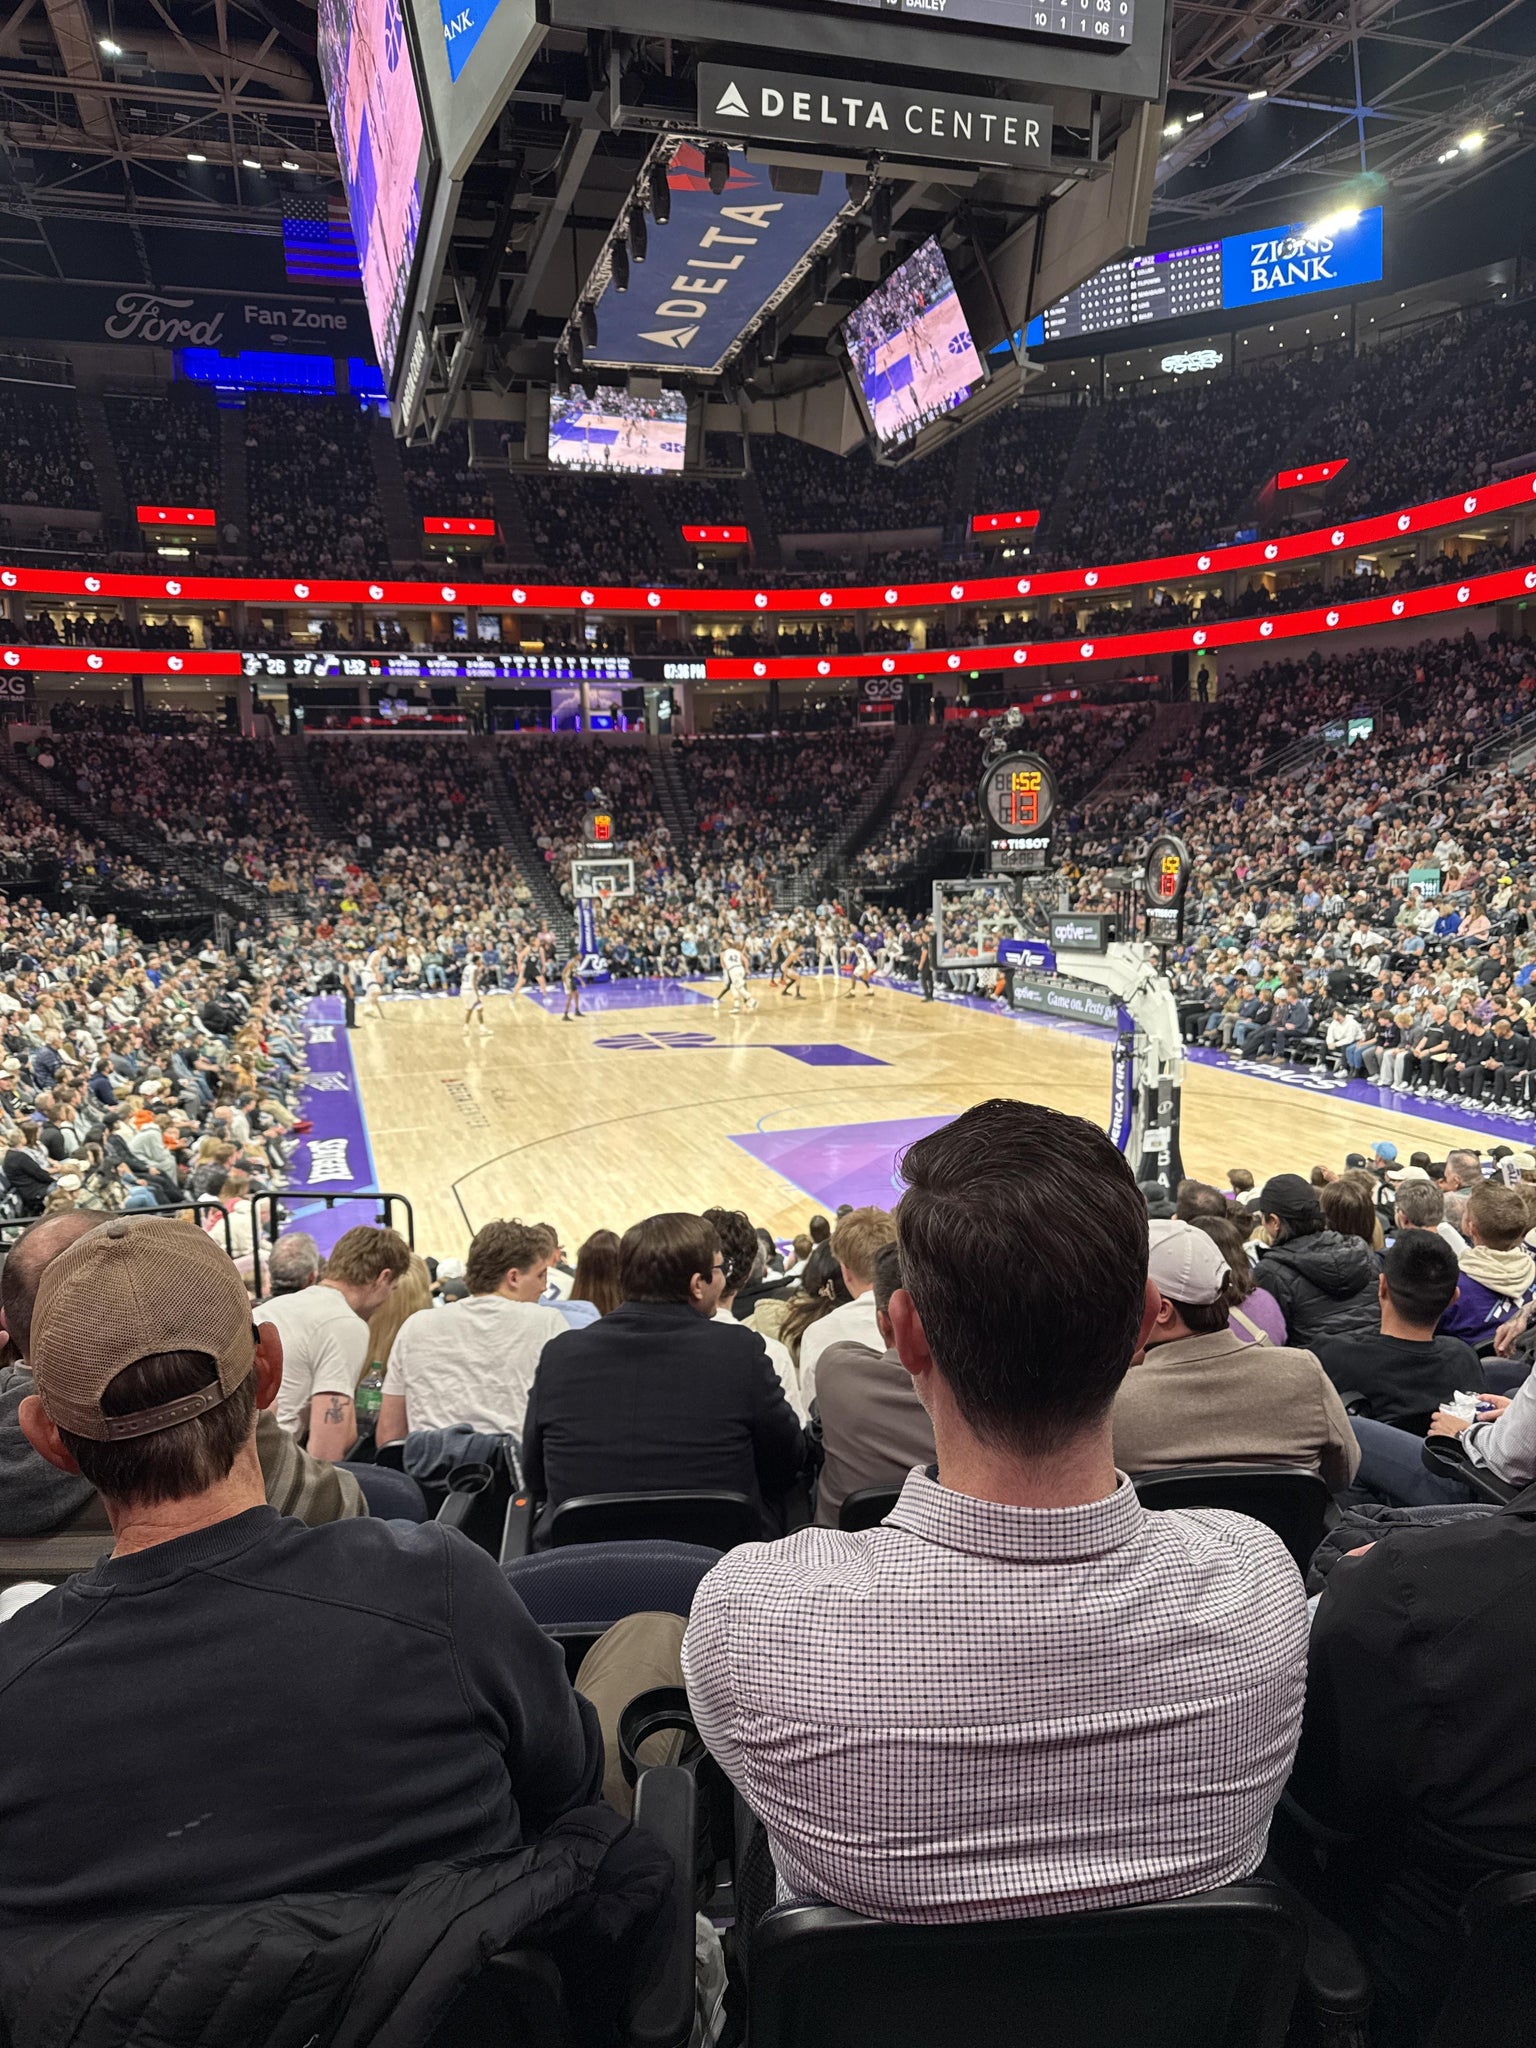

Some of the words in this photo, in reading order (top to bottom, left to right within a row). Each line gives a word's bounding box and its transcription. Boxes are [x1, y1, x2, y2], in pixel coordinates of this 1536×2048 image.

[1096, 0, 1111, 12] 03
[1120, 2, 1128, 15] 0
[444, 7, 473, 41] ANK
[1034, 12, 1047, 26] 10
[1060, 16, 1066, 30] 1
[1080, 19, 1086, 32] 1
[1094, 21, 1110, 35] 06
[1119, 24, 1125, 38] 1
[761, 87, 889, 131] DELTA
[904, 105, 1041, 148] CENTER
[655, 202, 784, 318] DELTA
[1250, 255, 1335, 292] BANK
[104, 292, 225, 346] Ford
[244, 304, 287, 326] Fan
[291, 308, 347, 330] Zone
[266, 659, 287, 675] 26
[293, 659, 312, 675] 27
[0, 676, 26, 694] 2G
[864, 678, 904, 695] G2G
[1011, 771, 1042, 791] 1:52
[1010, 791, 1038, 825] 13
[1008, 838, 1050, 850] TISSOT
[1047, 990, 1070, 1009] Game
[1115, 1040, 1127, 1090] FIRT
